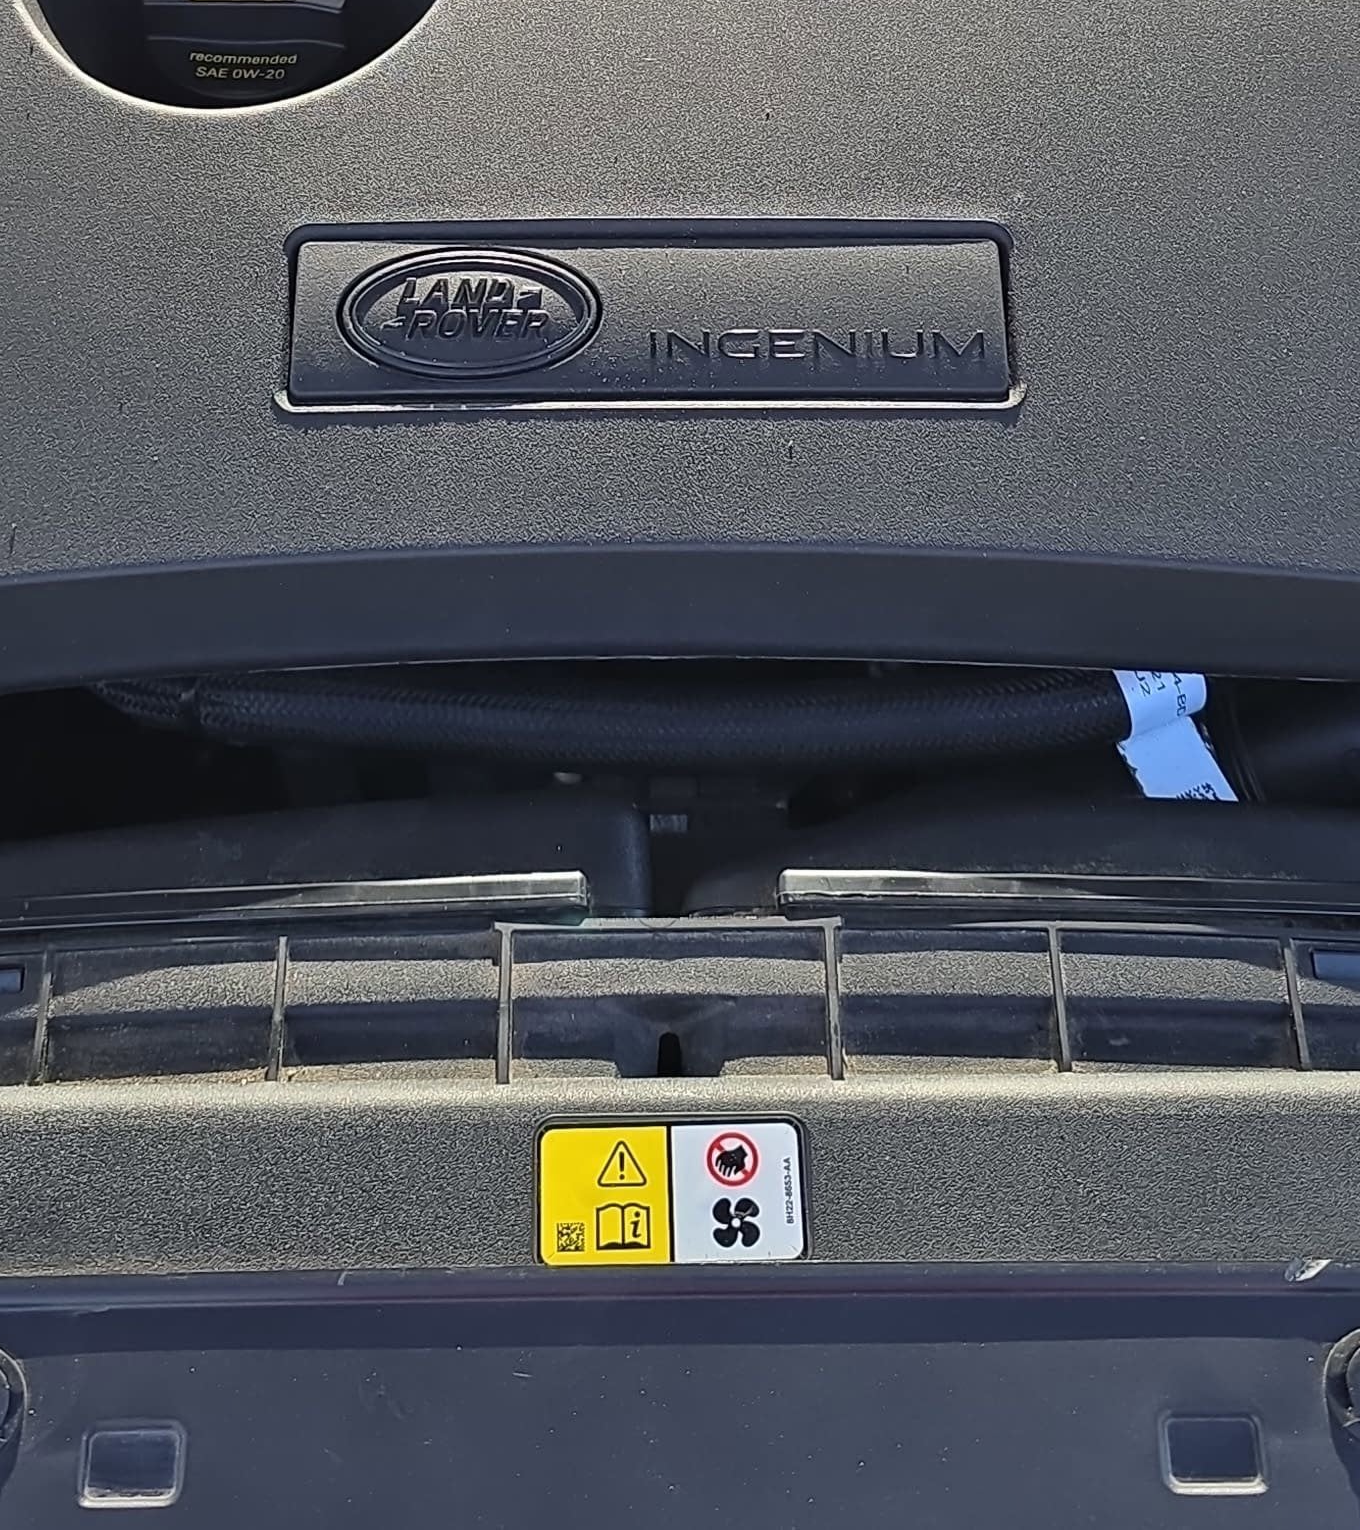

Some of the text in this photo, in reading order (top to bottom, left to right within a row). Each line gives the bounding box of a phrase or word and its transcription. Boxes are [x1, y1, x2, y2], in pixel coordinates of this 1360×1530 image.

[189, 52, 299, 65] recommended
[195, 66, 286, 80] SAE 0W-20
[649, 328, 986, 360] INGENIUM
